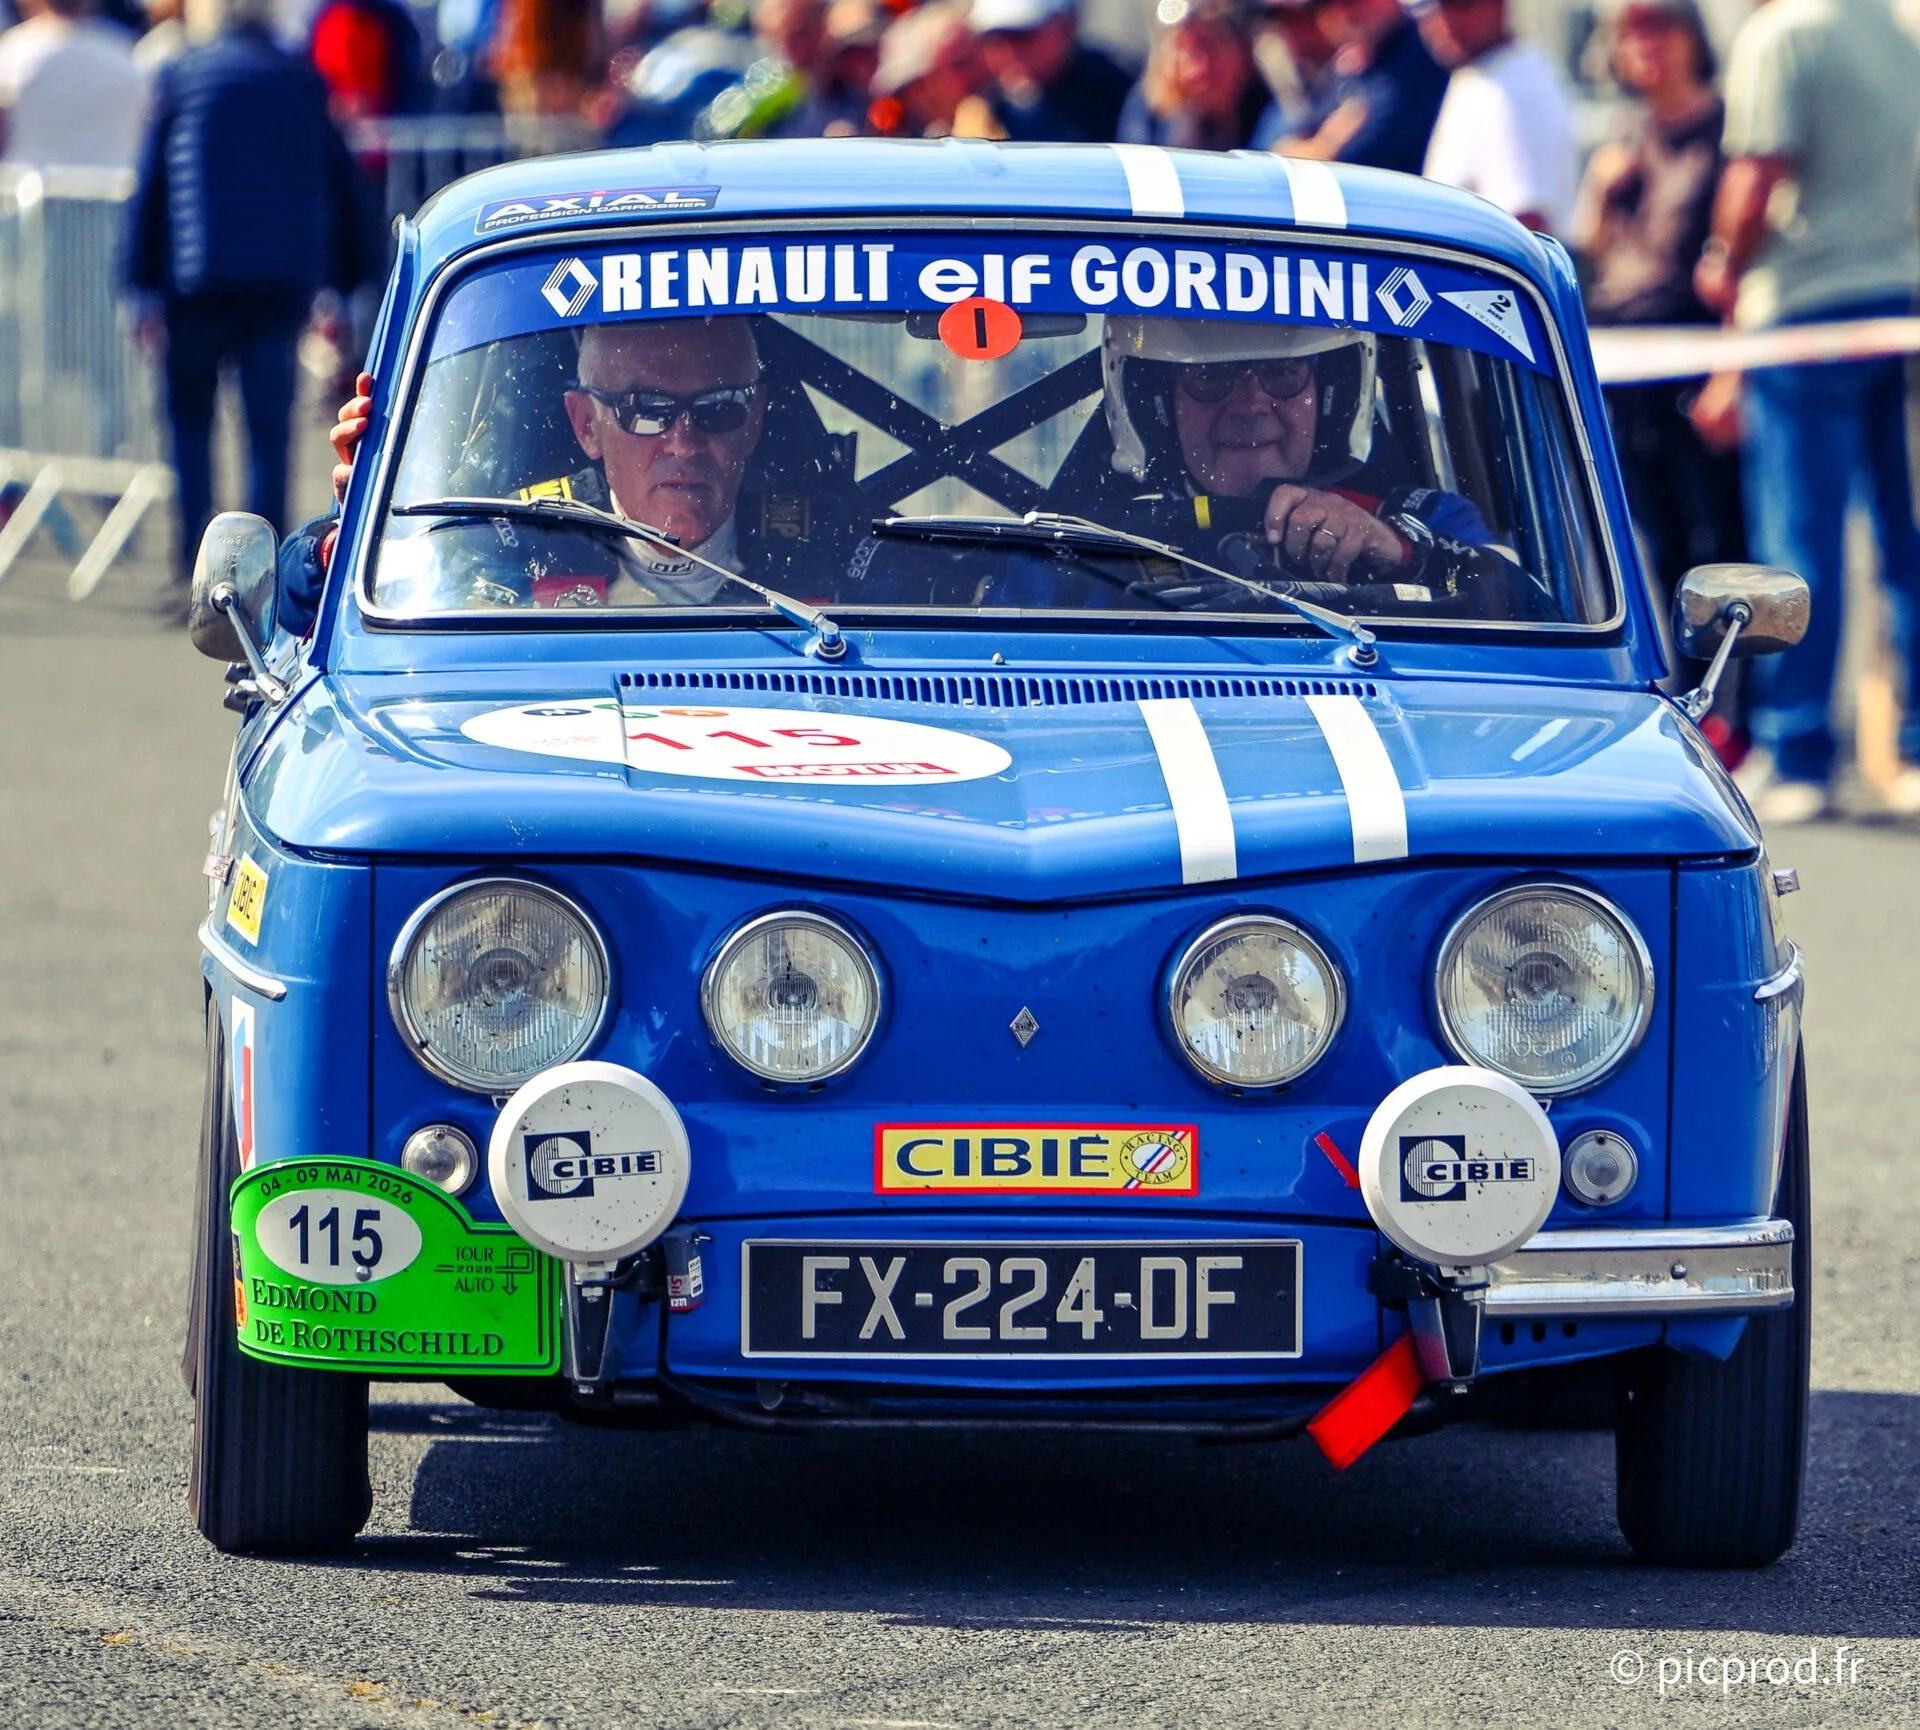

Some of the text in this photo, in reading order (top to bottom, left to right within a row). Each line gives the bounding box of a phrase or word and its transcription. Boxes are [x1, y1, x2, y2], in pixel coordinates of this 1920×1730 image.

[484, 202, 707, 229] PROFESSION CARROSSIER
[602, 243, 1369, 322] RENAULT elf GORDINI
[1489, 294, 1512, 313] 2
[626, 728, 861, 750] 115
[750, 763, 947, 777] MOTUL
[1125, 1133, 1183, 1153] RACING
[260, 1177, 281, 1196] 04
[296, 1168, 319, 1184] 09
[325, 1167, 361, 1184] MAI
[367, 1174, 413, 1204] 2026
[1135, 1169, 1174, 1183] TEAM
[289, 1204, 383, 1267] 115
[454, 1246, 494, 1262] TOUR
[456, 1265, 493, 1274] 2026
[251, 1277, 377, 1314] EDMOND
[454, 1277, 495, 1293] AUTO
[802, 1256, 1243, 1340] FX-224-DF
[255, 1319, 505, 1357] DE ROTHSCHILD
